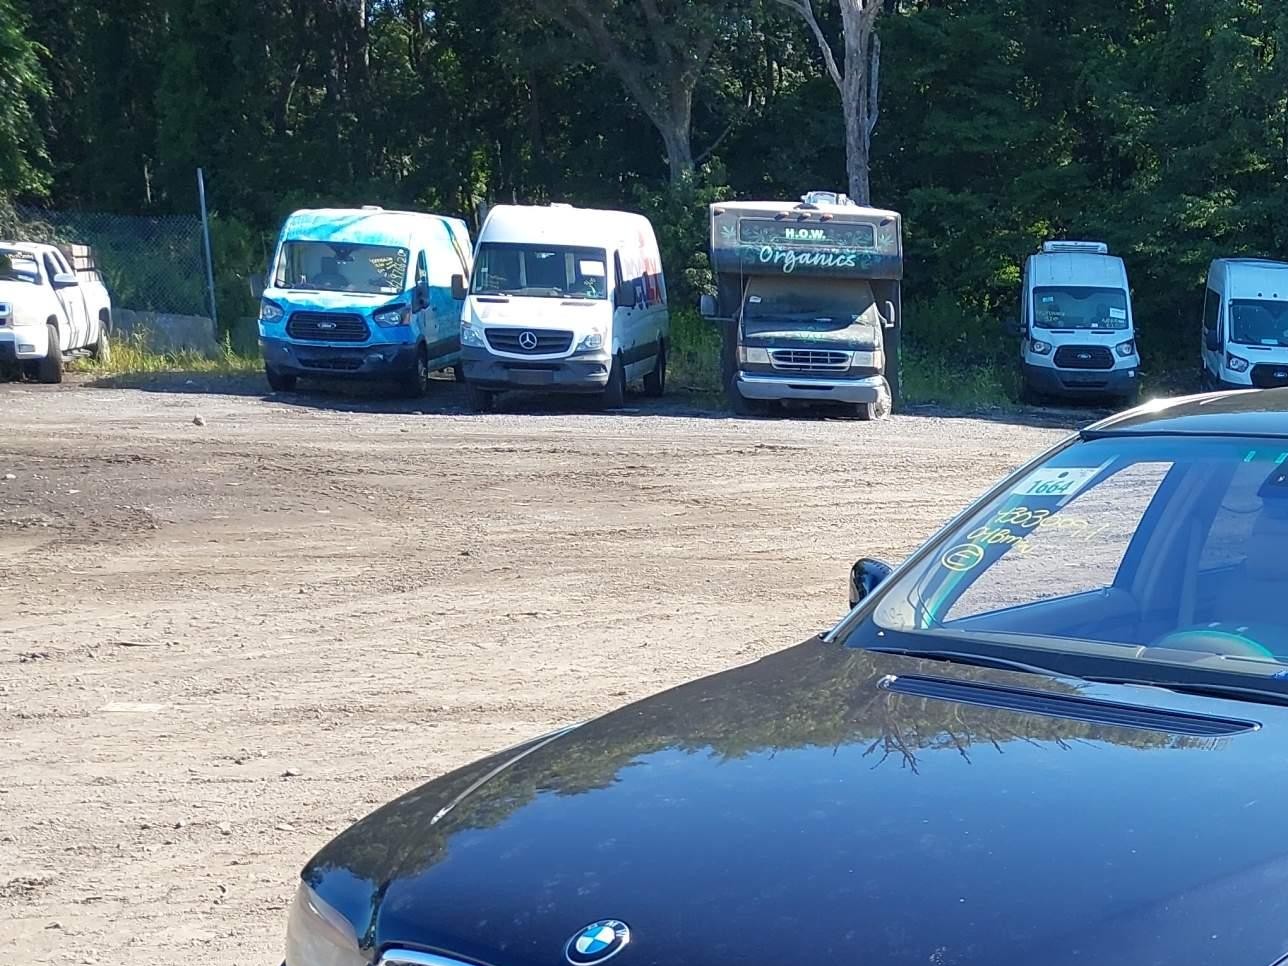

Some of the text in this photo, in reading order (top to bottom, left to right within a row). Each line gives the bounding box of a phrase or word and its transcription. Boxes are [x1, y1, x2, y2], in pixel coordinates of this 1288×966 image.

[785, 228, 826, 239] H.O.W.
[760, 246, 856, 273] Organics
[1027, 480, 1074, 494] 1664
